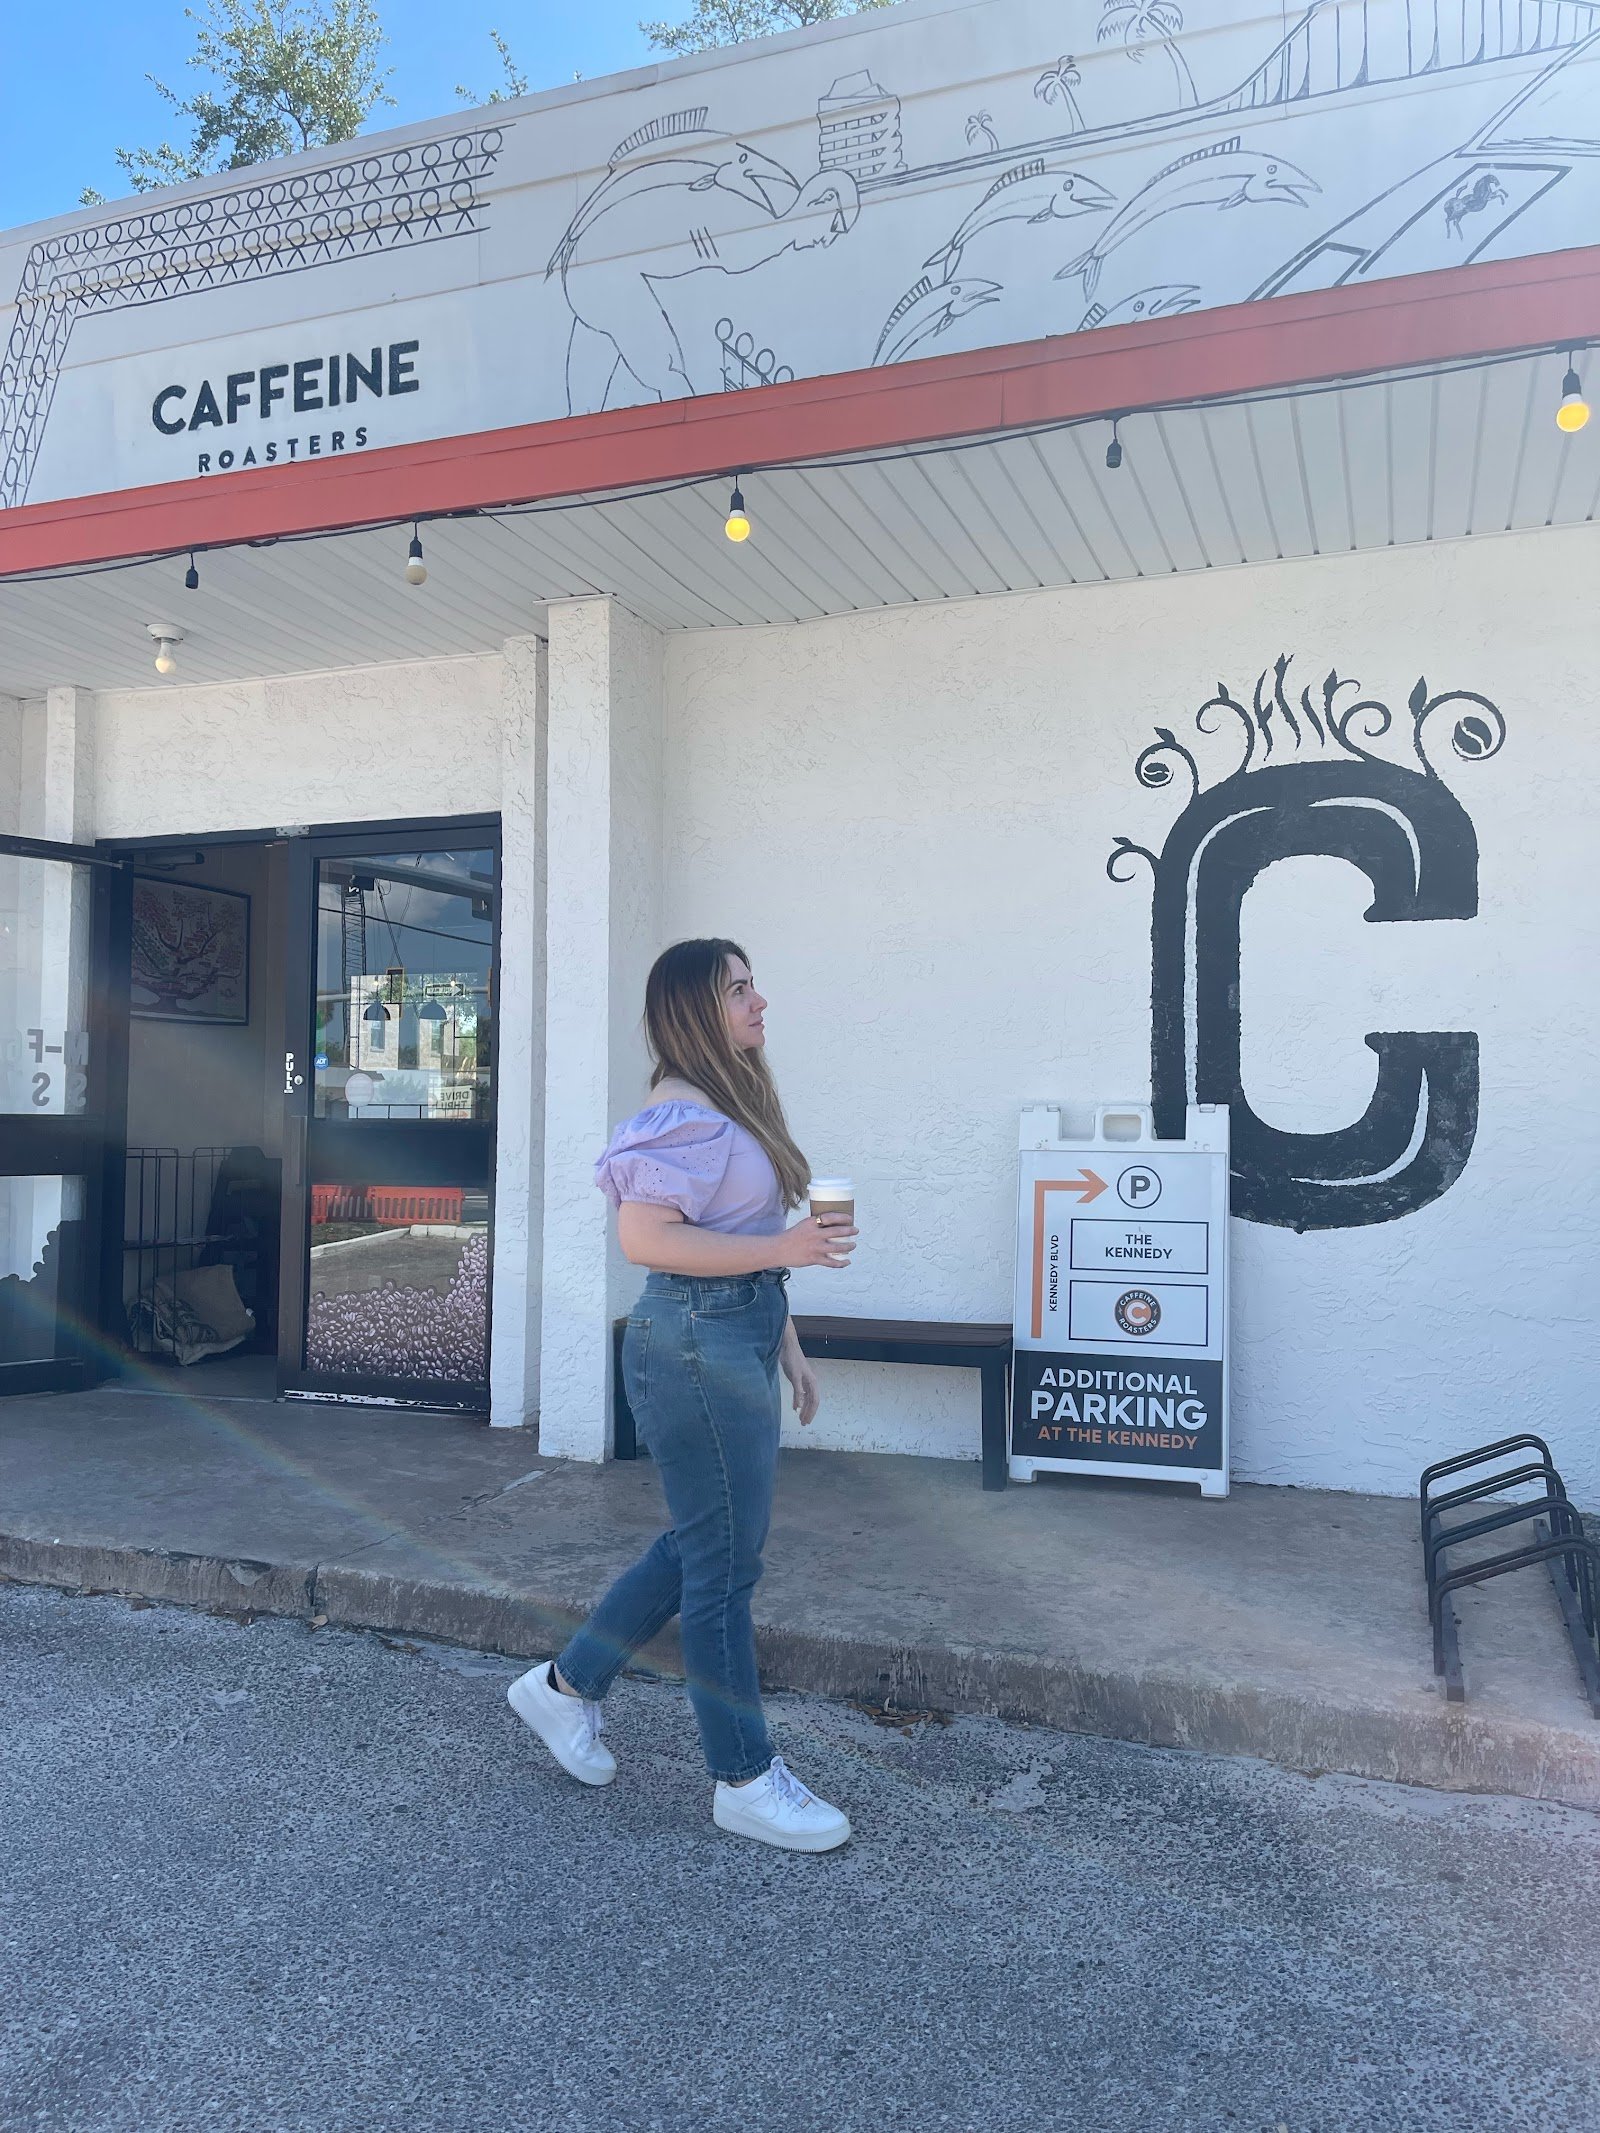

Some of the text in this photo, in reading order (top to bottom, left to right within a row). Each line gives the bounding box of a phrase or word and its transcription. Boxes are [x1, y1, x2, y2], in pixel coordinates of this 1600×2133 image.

[152, 340, 420, 435] CAFFEINE
[198, 427, 368, 473] ROASTERS
[285, 1052, 294, 1090] PULL
[1130, 1175, 1151, 1199] P
[1125, 1234, 1153, 1245] THE
[1105, 1246, 1173, 1260] KENNEDY
[1049, 1234, 1059, 1312] KENNEDY BLVD
[1120, 1292, 1157, 1307] CAFFEINE
[1119, 1318, 1157, 1333] ROASTERS
[1039, 1367, 1198, 1395] ADDITIONAL
[1030, 1390, 1208, 1430] PARKING
[1037, 1425, 1198, 1450] AT THE KENNEDY
